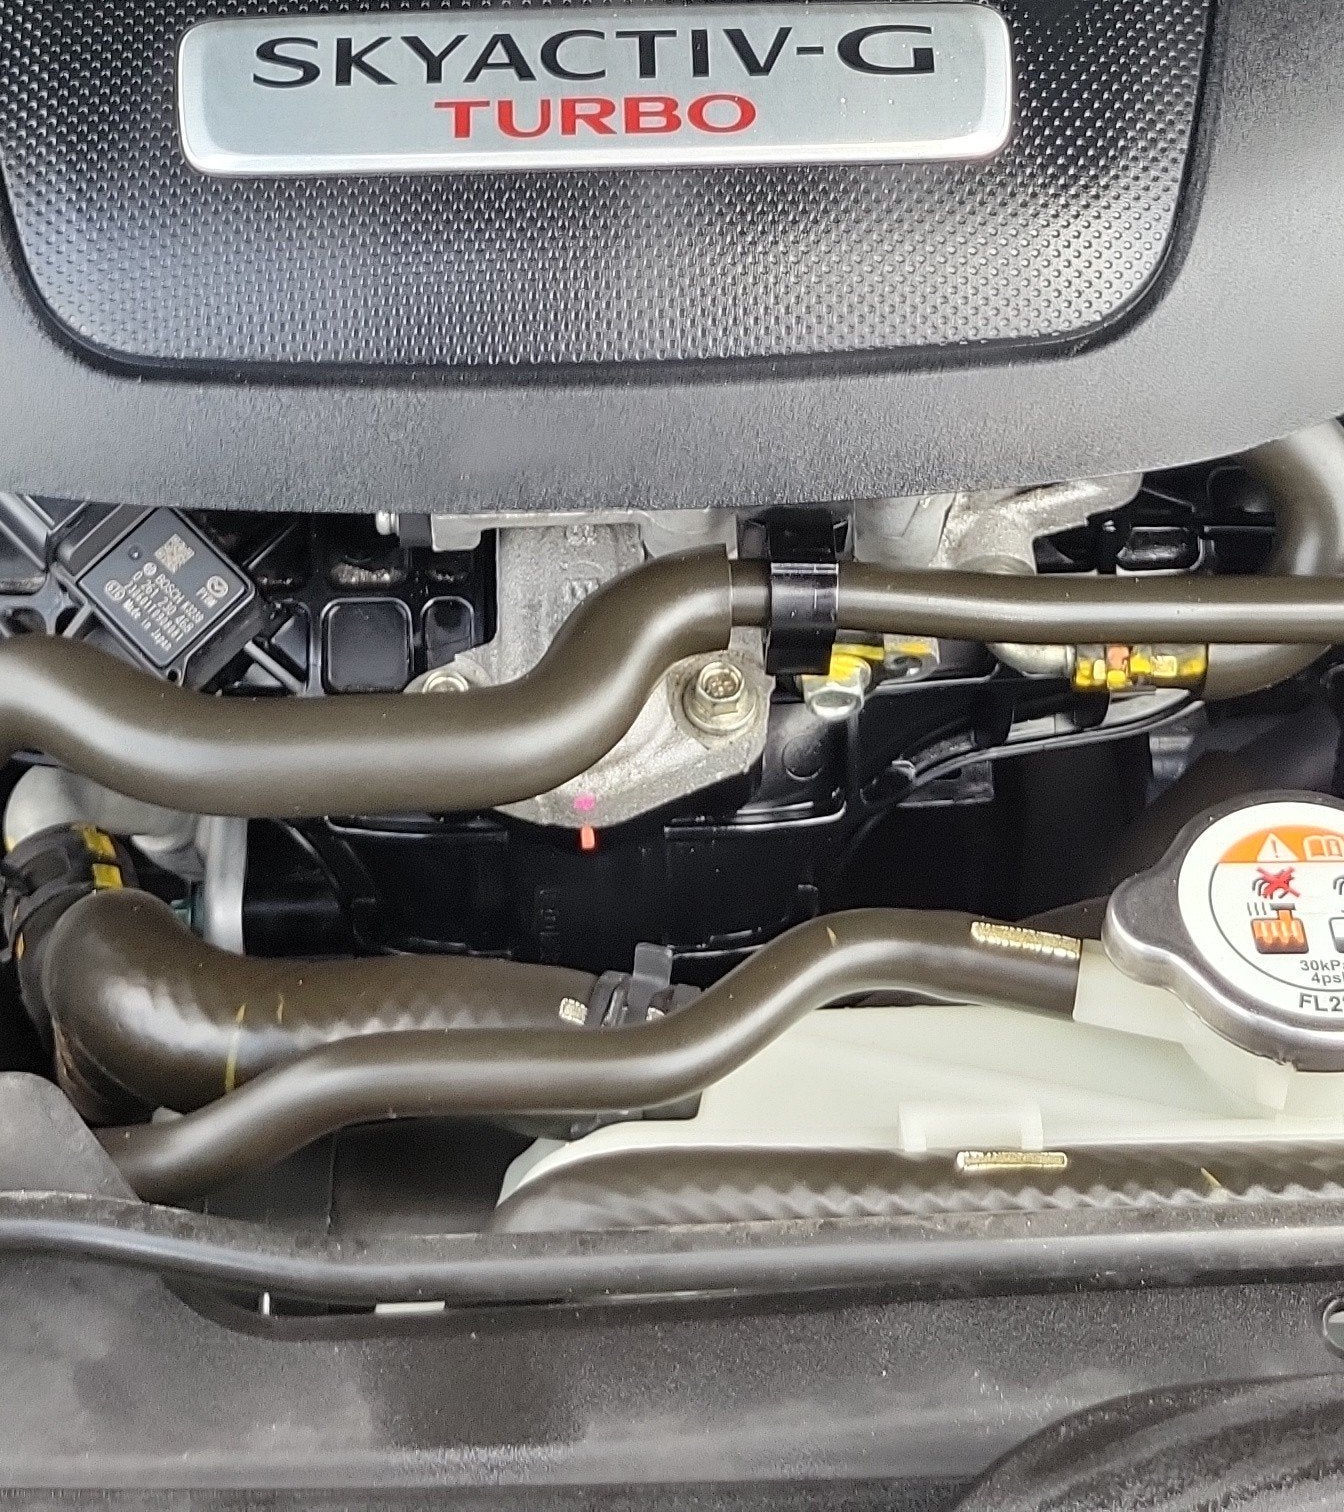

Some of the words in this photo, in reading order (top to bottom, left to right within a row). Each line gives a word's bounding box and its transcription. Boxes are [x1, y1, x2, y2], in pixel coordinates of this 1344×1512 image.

[251, 23, 936, 87] SKYACTIV-G
[434, 94, 758, 139] TURBO
[141, 580, 159, 599] 261
[157, 596, 177, 615] 230
[156, 574, 185, 604] BOSCH
[122, 598, 141, 619] Made
[142, 618, 152, 630] in
[151, 629, 172, 652] Japan
